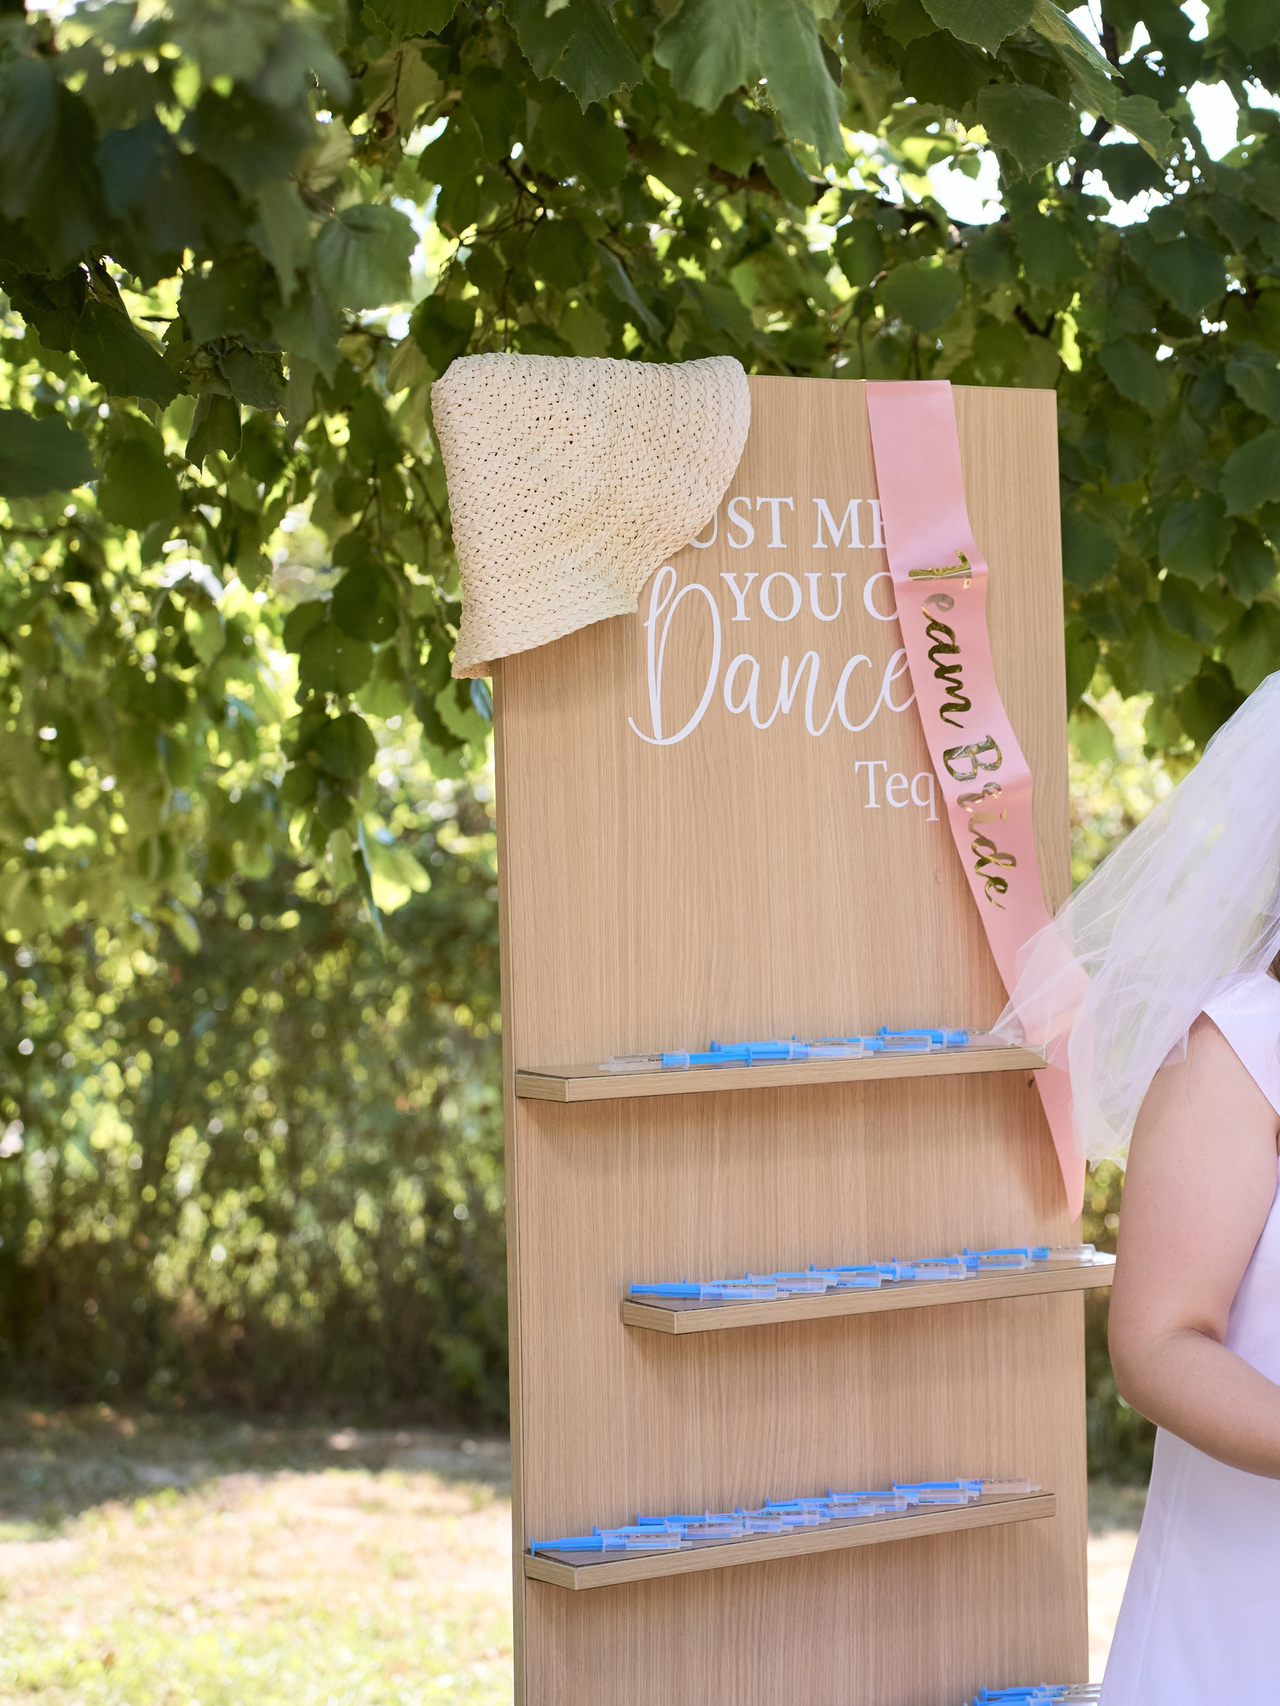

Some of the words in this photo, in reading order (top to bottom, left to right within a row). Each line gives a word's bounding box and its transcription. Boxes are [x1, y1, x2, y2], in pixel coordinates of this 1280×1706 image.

[627, 565, 917, 746] Dance
[719, 571, 847, 622] YOU
[907, 549, 973, 729] Team
